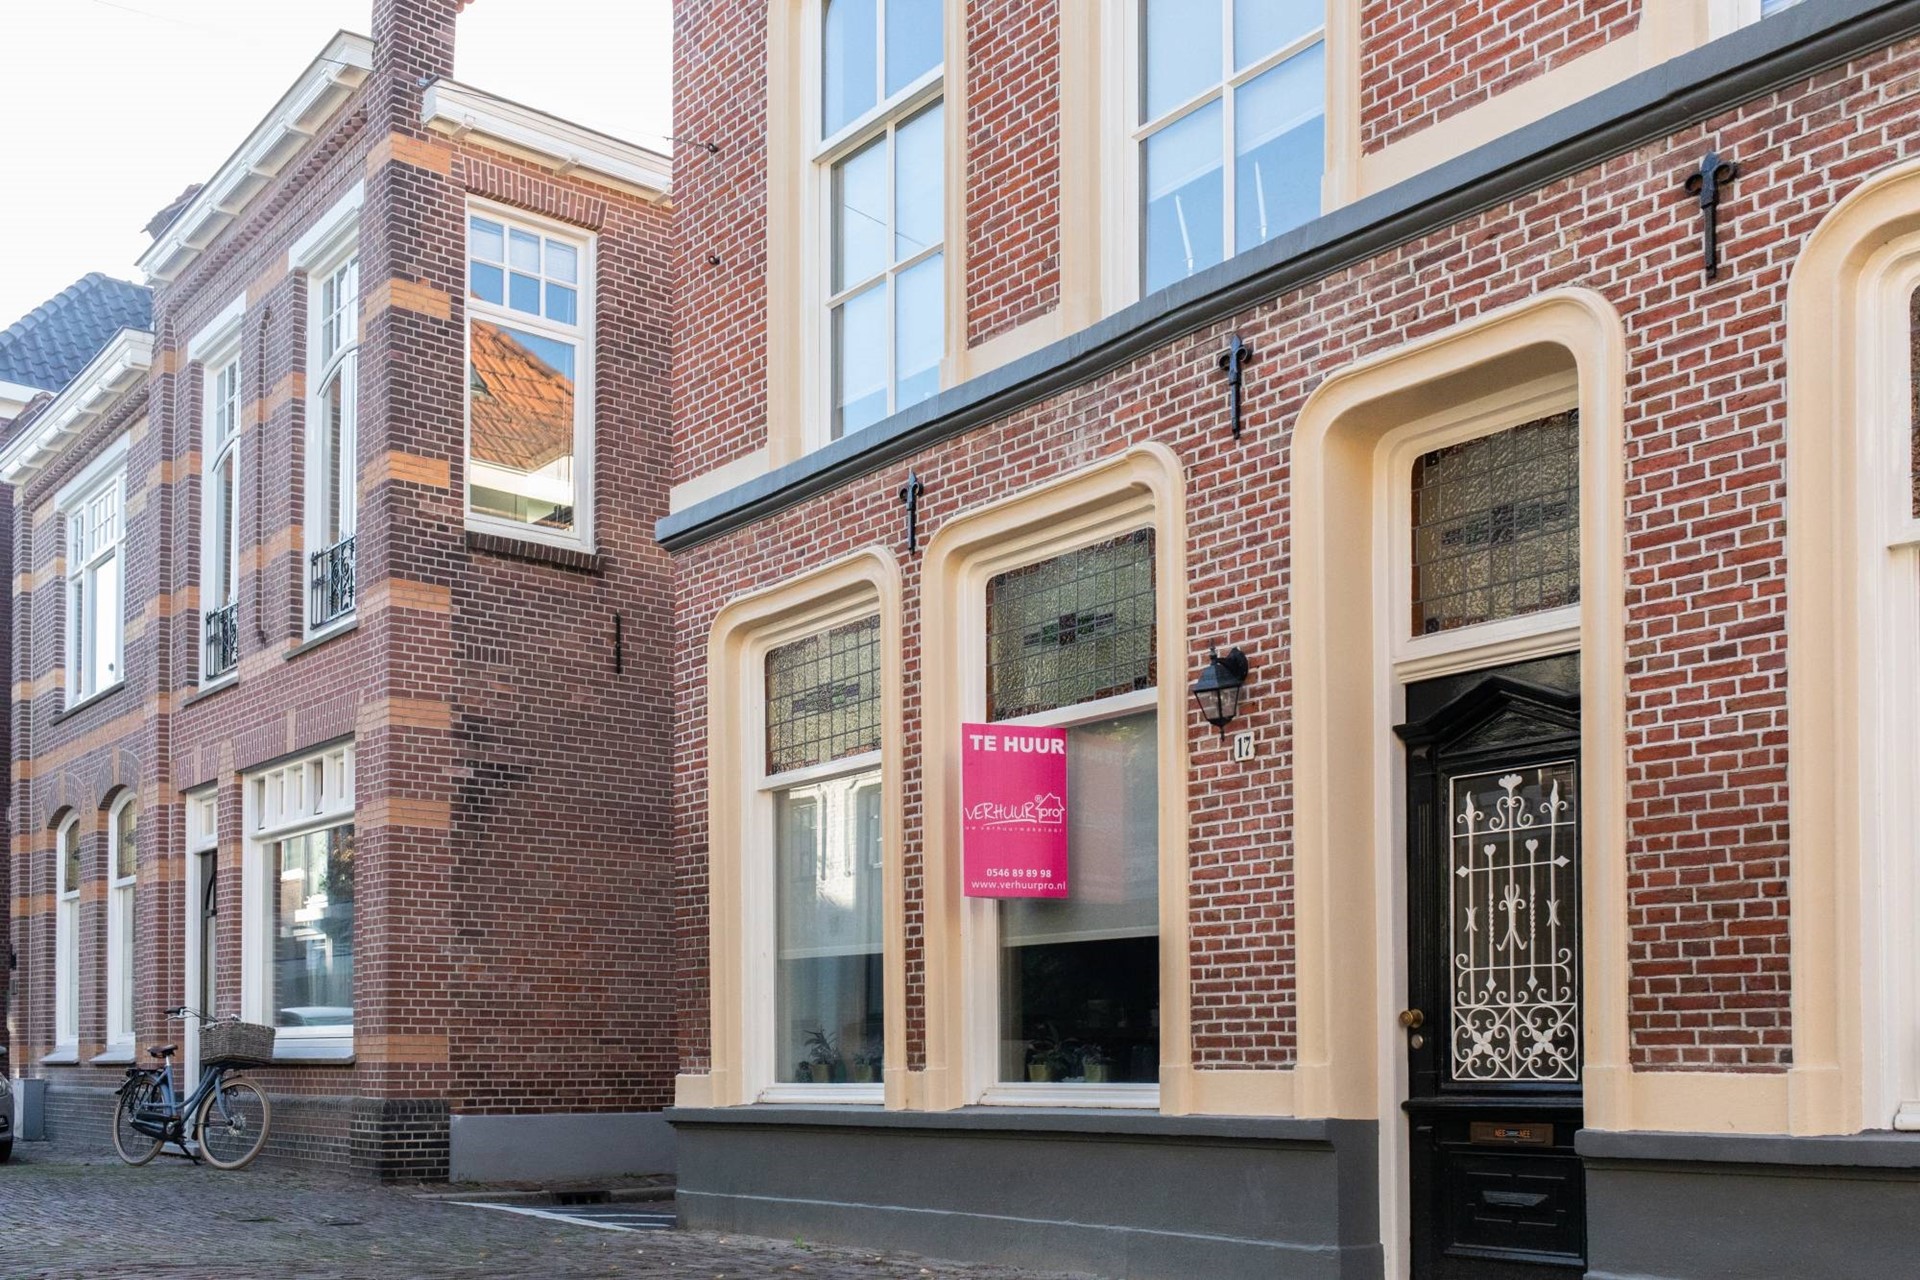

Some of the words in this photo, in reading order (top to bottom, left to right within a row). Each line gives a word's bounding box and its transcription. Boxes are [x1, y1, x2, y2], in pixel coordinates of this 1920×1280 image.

[969, 734, 997, 751] TE
[1003, 736, 1065, 754] HUUR
[1238, 736, 1251, 758] 17
[965, 801, 1036, 820] VERHUUR
[1040, 808, 1060, 819] pro
[986, 868, 1010, 877] 0546
[1012, 868, 1024, 877] 89
[1026, 869, 1038, 878] 89
[1040, 869, 1052, 878] 98
[971, 880, 1066, 891] www.verhuurpro.nl
